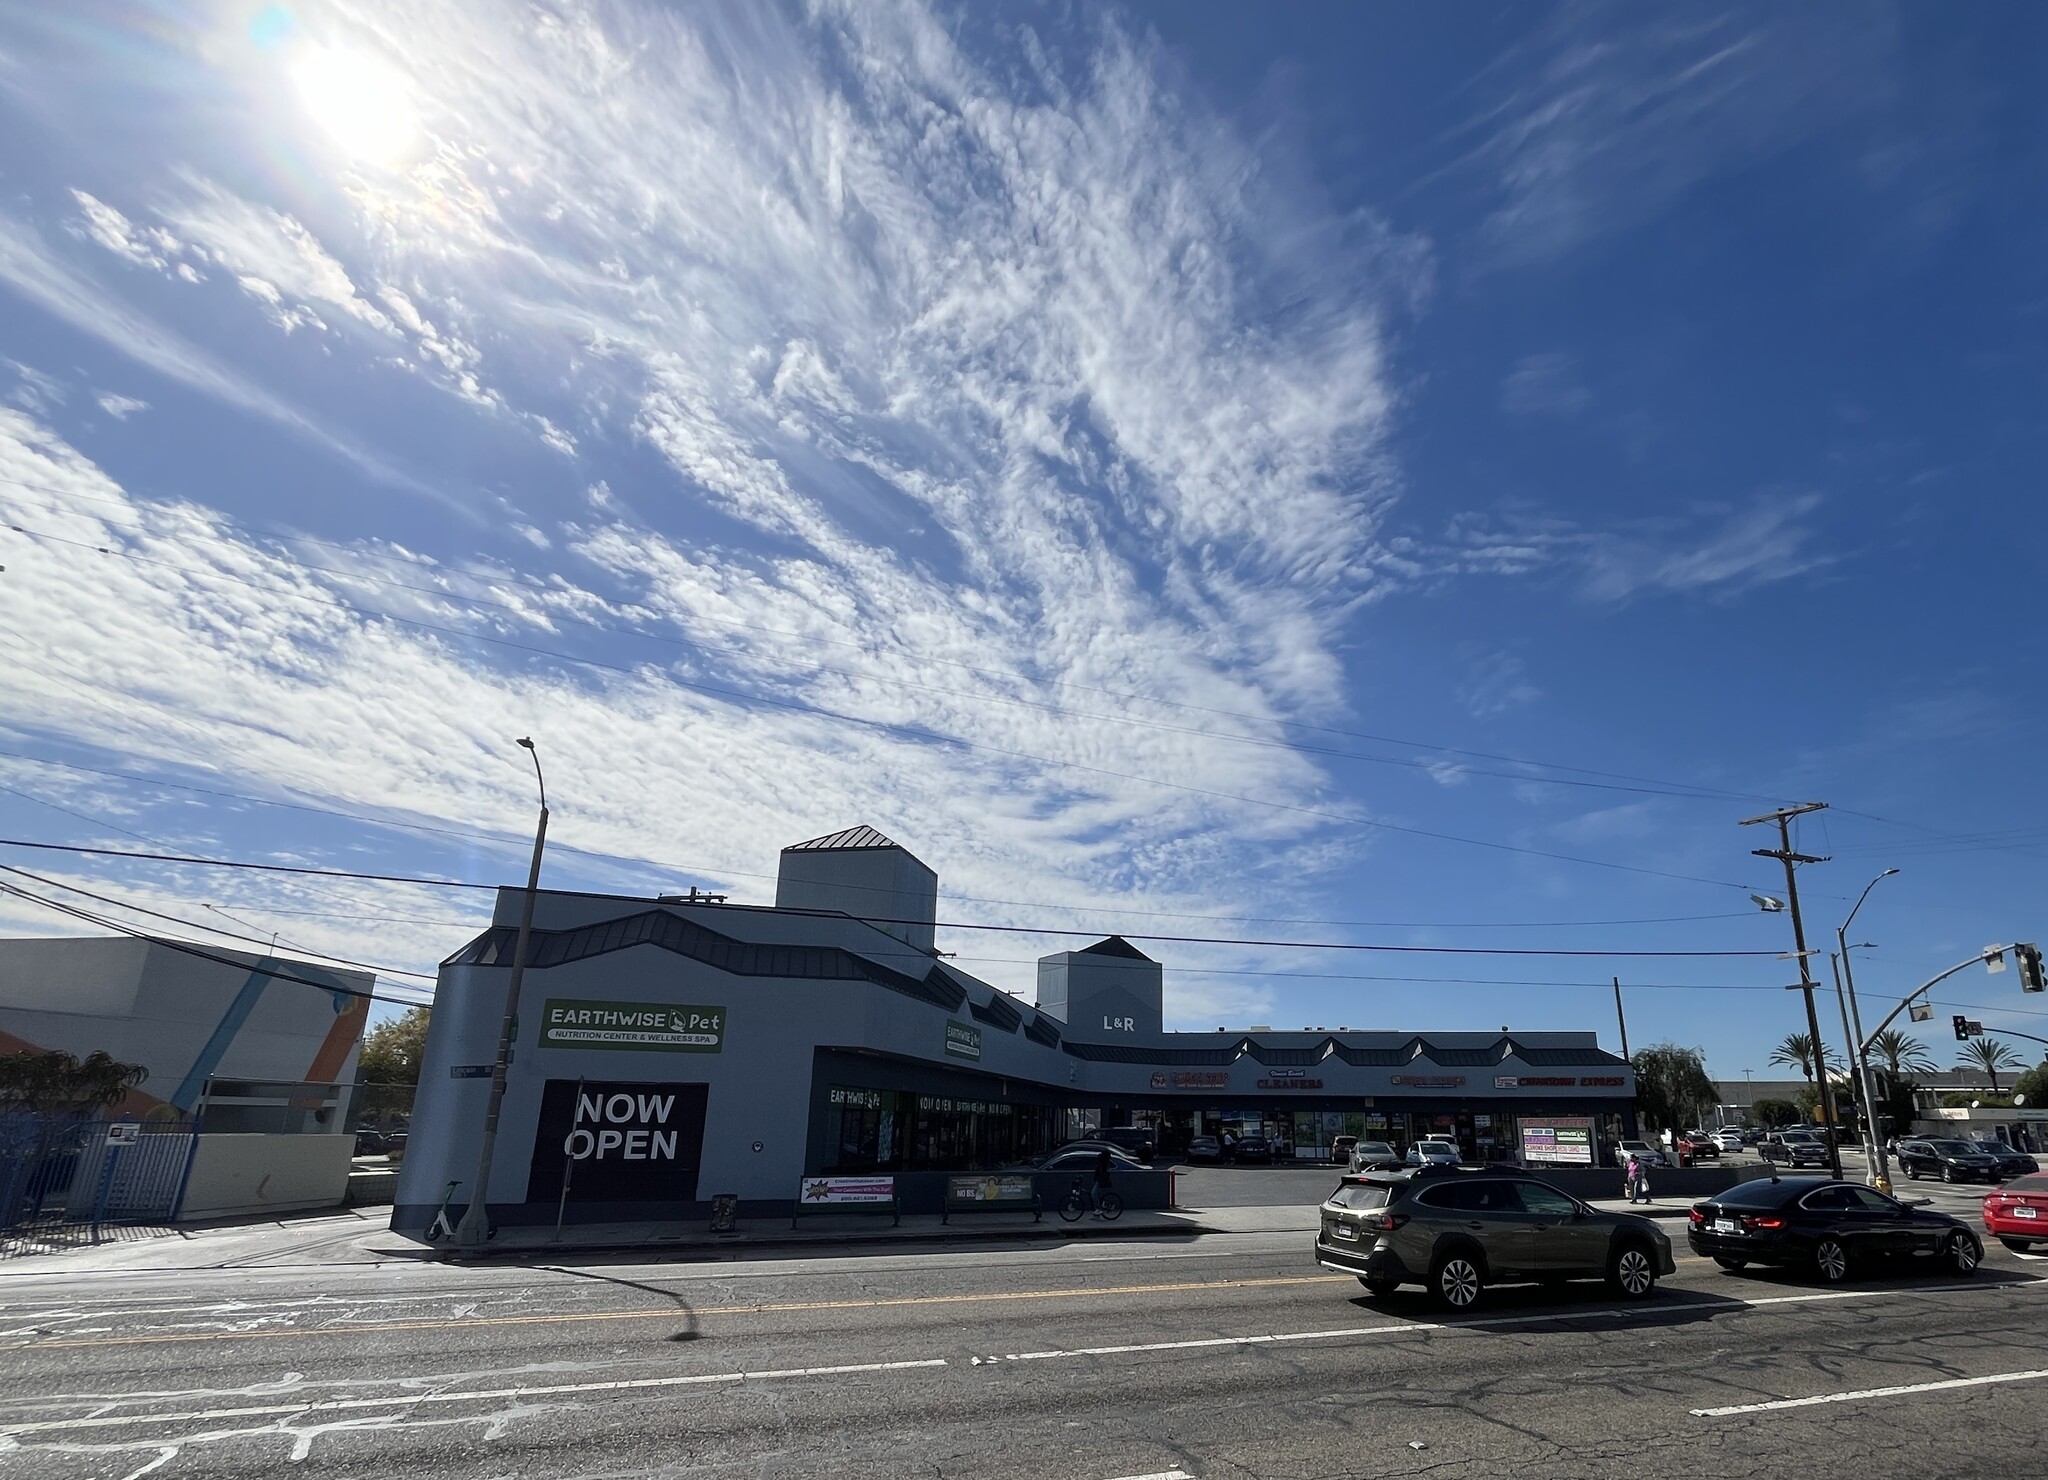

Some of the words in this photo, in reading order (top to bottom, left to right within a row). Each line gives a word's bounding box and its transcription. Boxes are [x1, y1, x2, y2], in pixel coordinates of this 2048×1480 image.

[550, 1008, 667, 1028] EARTHWISE
[688, 1014, 720, 1030] Pet
[1103, 1015, 1135, 1032] L&R
[555, 1030, 602, 1040] NUTRITION
[603, 1032, 638, 1040] CENTER
[647, 1033, 692, 1042] WELLNESS
[1256, 1079, 1323, 1089] CLEANERS
[576, 1093, 676, 1124] NOW
[564, 1129, 678, 1160] OPEN
